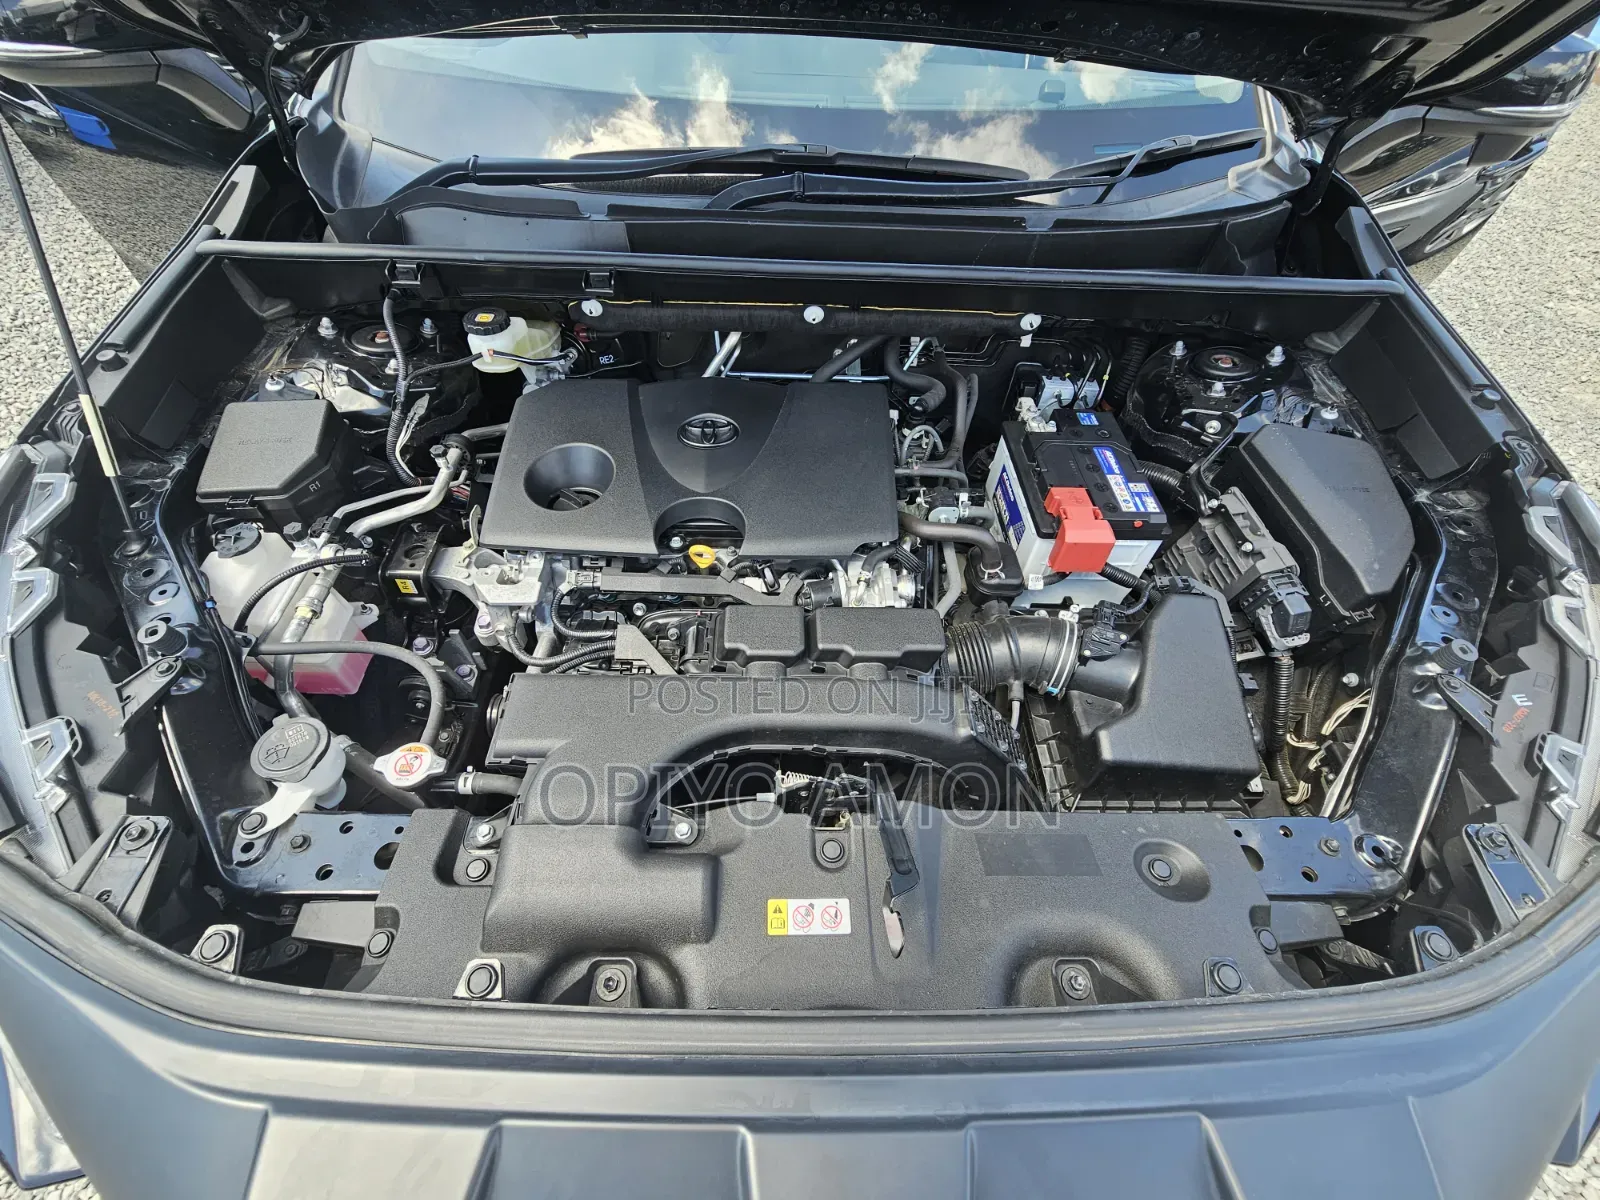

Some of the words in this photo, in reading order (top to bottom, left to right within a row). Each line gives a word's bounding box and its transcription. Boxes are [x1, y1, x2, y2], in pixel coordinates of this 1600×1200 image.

[599, 354, 615, 364] RE2
[308, 480, 321, 493] R1
[1319, 593, 1332, 607] L1
